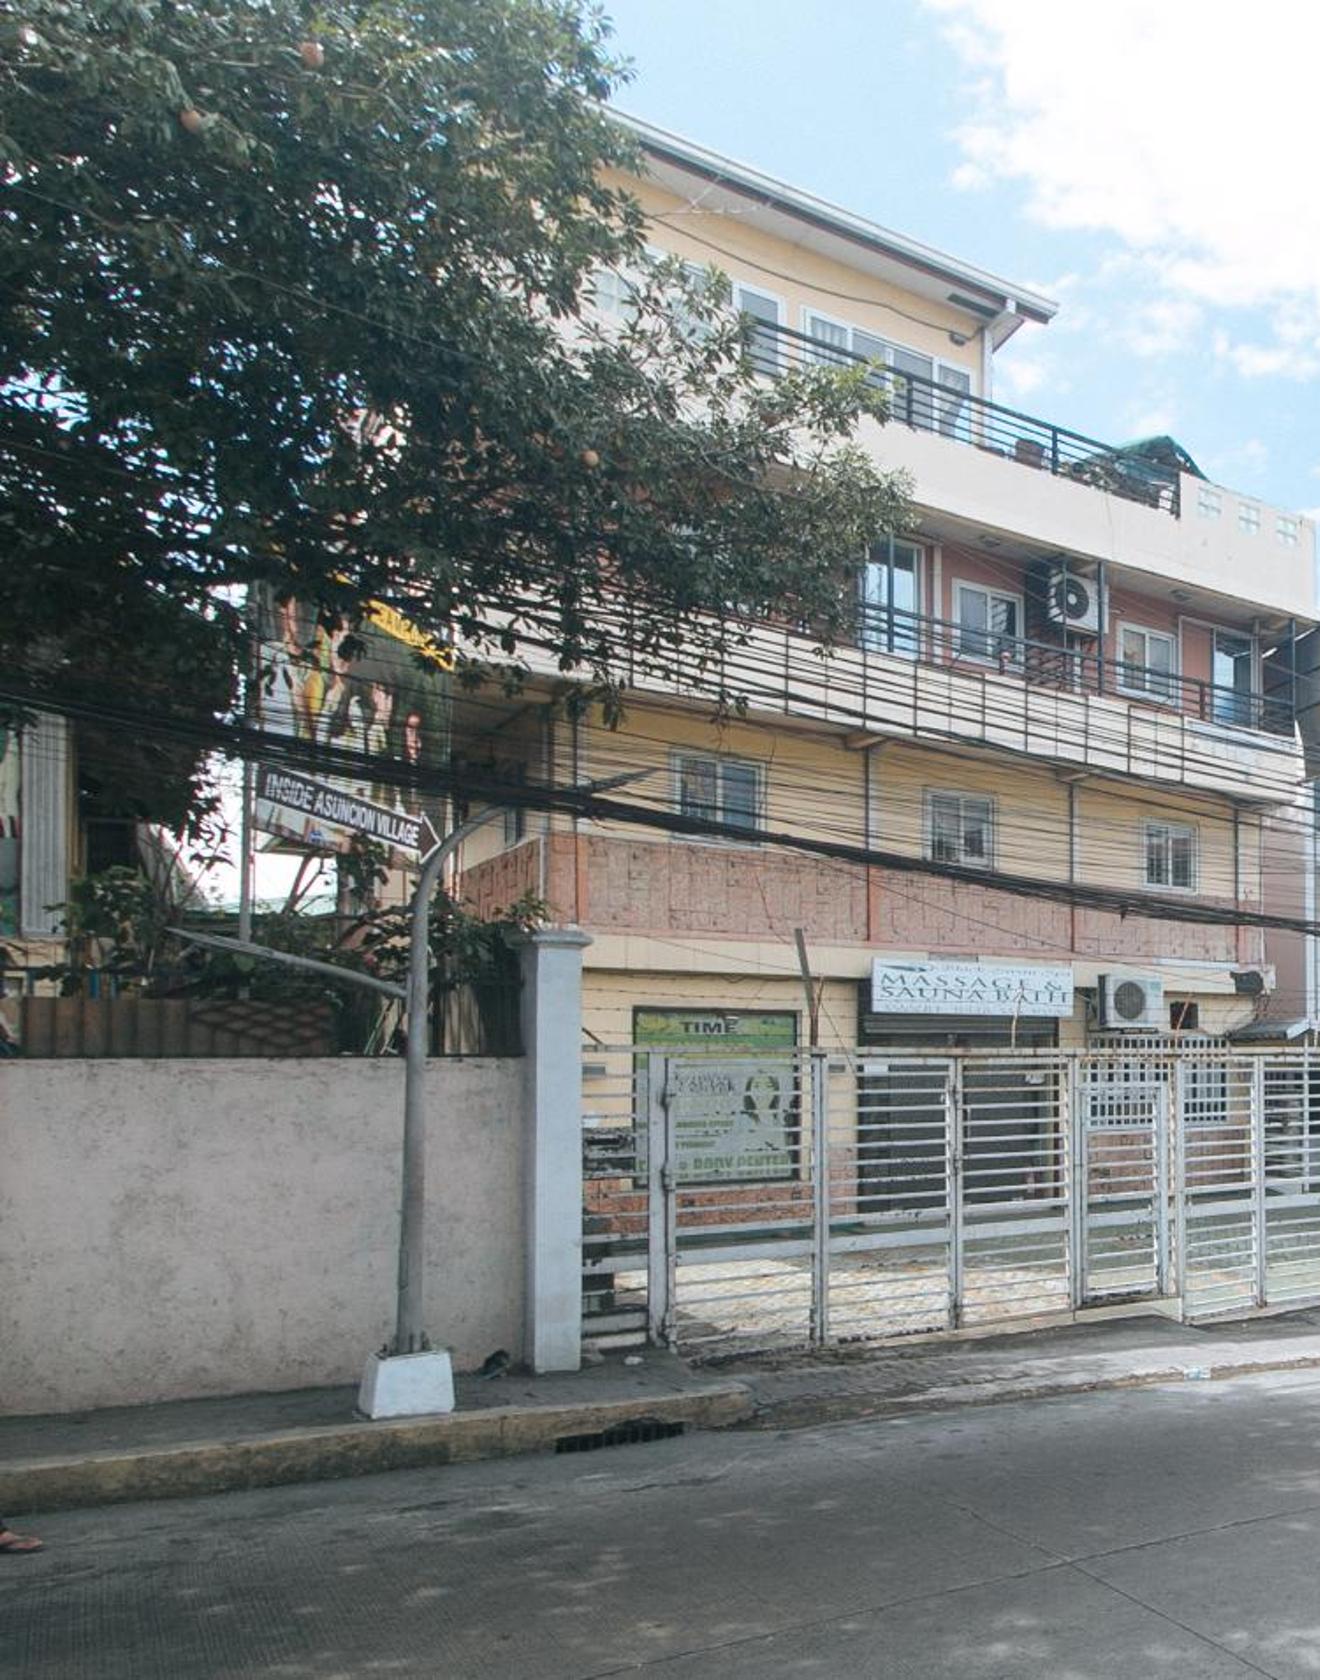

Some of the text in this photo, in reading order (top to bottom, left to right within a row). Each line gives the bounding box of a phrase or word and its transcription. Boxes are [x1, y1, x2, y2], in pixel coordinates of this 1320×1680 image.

[265, 773, 421, 847] INSIDE ASUNCION VILLAGE
[880, 973, 1031, 991] MASSAGE
[880, 986, 1069, 1005] SAUNA BATH
[680, 1020, 739, 1035] TIME
